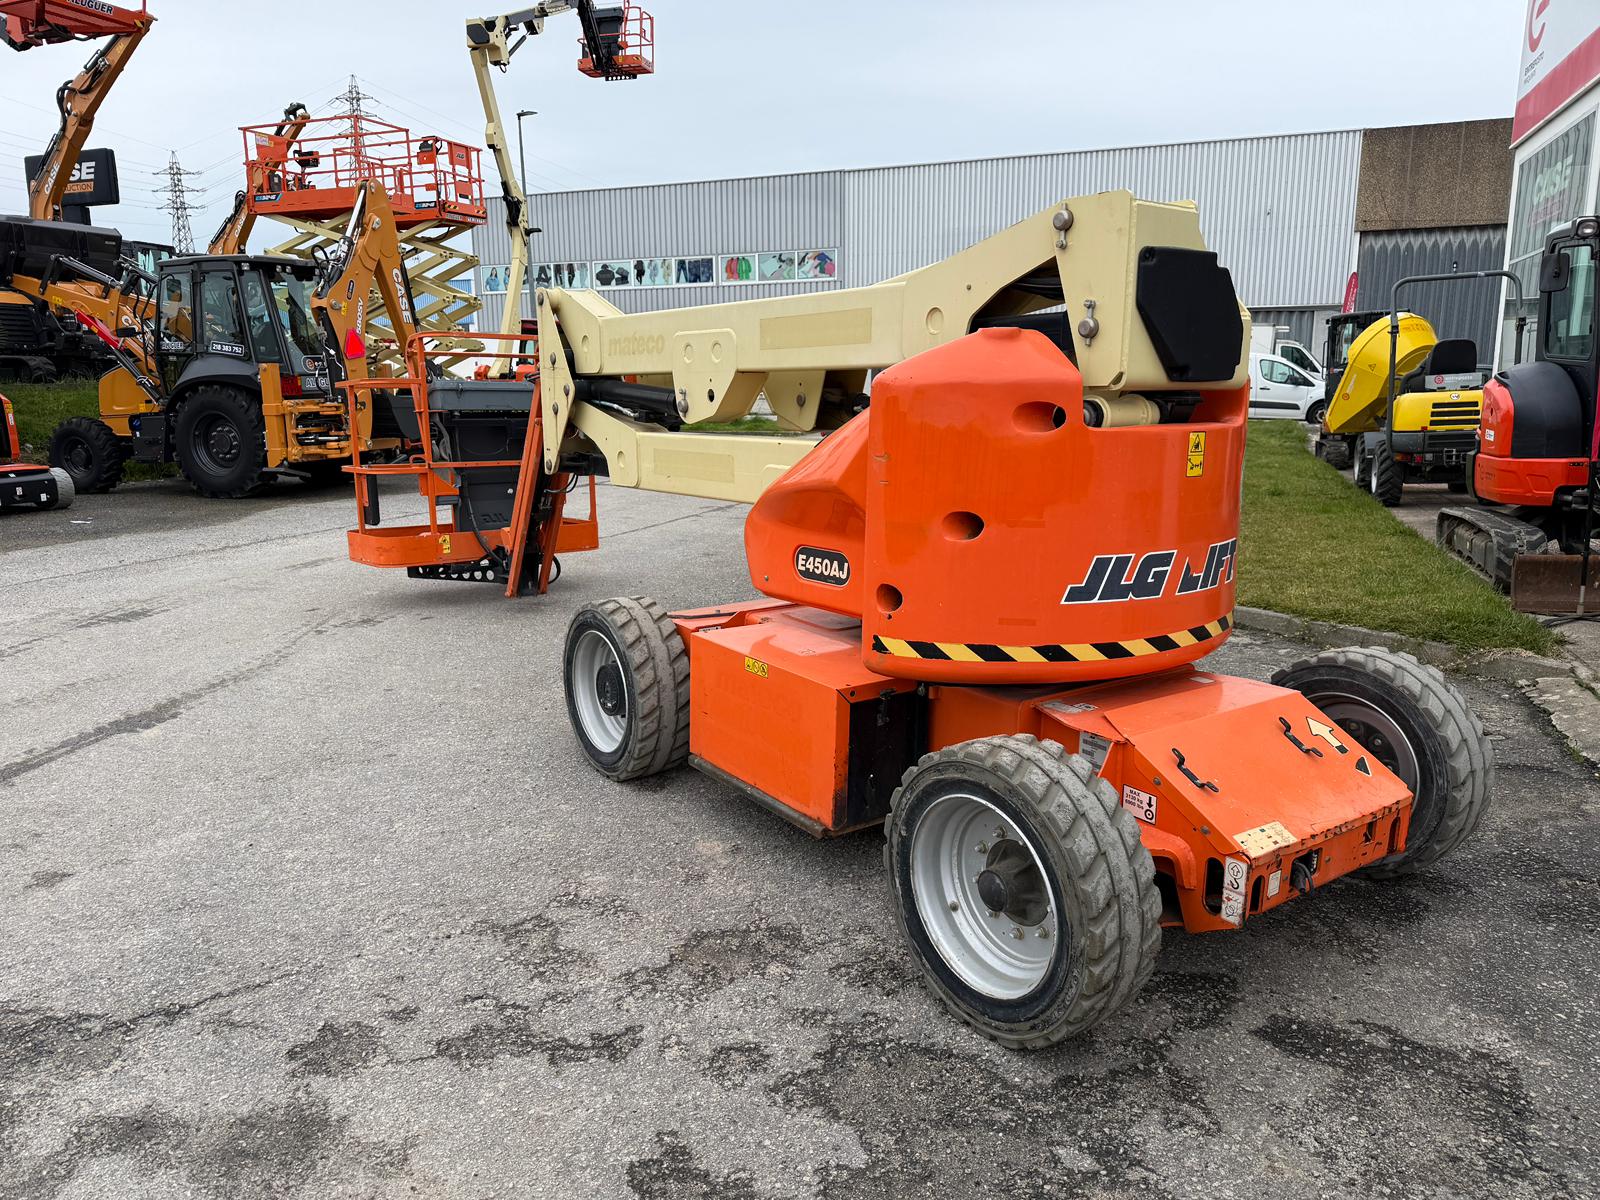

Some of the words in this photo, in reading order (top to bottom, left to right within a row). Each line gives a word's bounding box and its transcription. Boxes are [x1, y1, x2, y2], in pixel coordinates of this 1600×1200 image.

[44, 161, 60, 195] CASE
[69, 161, 96, 181] SE
[392, 268, 412, 324] CASE
[232, 346, 242, 354] 752
[608, 331, 664, 356] mateco
[797, 554, 848, 579] E450AJ
[1060, 550, 1177, 604] JLG
[1130, 789, 1140, 797] MAX
